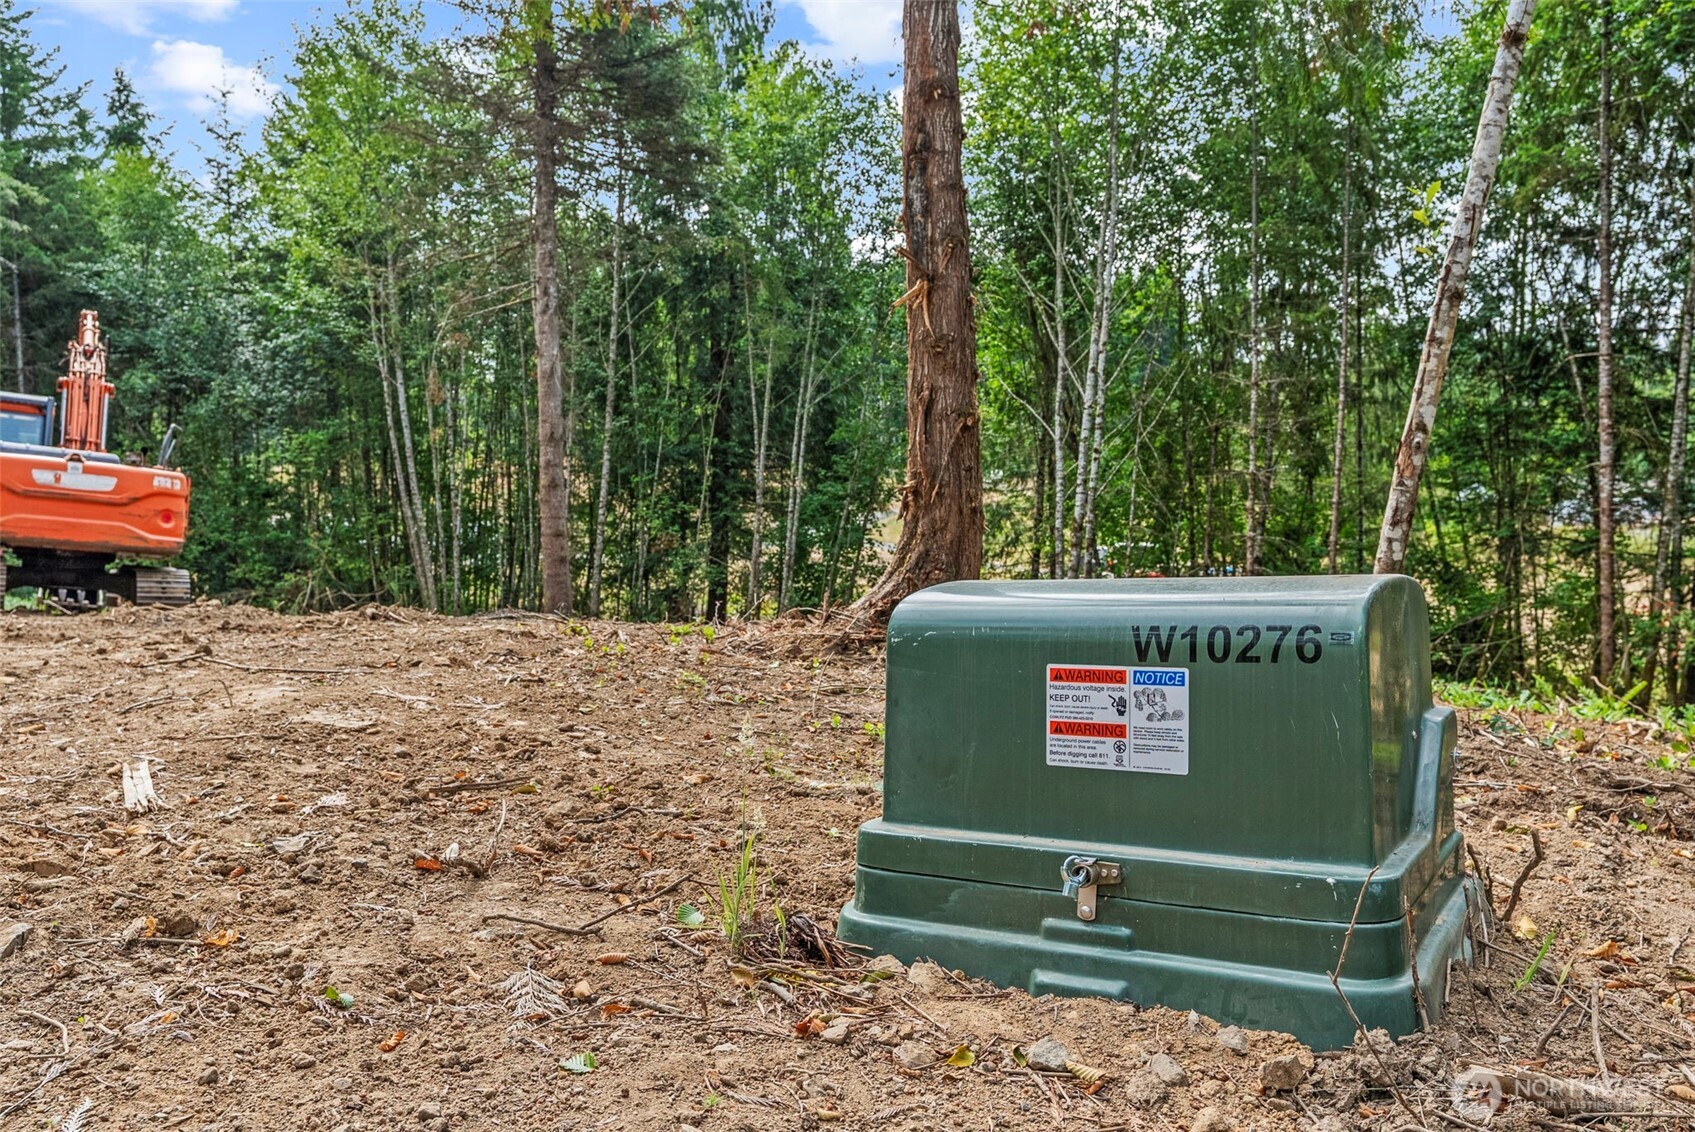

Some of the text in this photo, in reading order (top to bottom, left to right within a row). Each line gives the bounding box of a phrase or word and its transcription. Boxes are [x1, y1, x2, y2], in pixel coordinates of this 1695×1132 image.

[1131, 623, 1323, 664] W10276
[1064, 669, 1123, 682] WARNING
[1135, 672, 1184, 684] NOTICE
[1049, 683, 1081, 691] Hazardous
[1083, 685, 1105, 693] voltage
[1049, 694, 1091, 703] KEEP OUT!
[1064, 723, 1123, 737] WARNING
